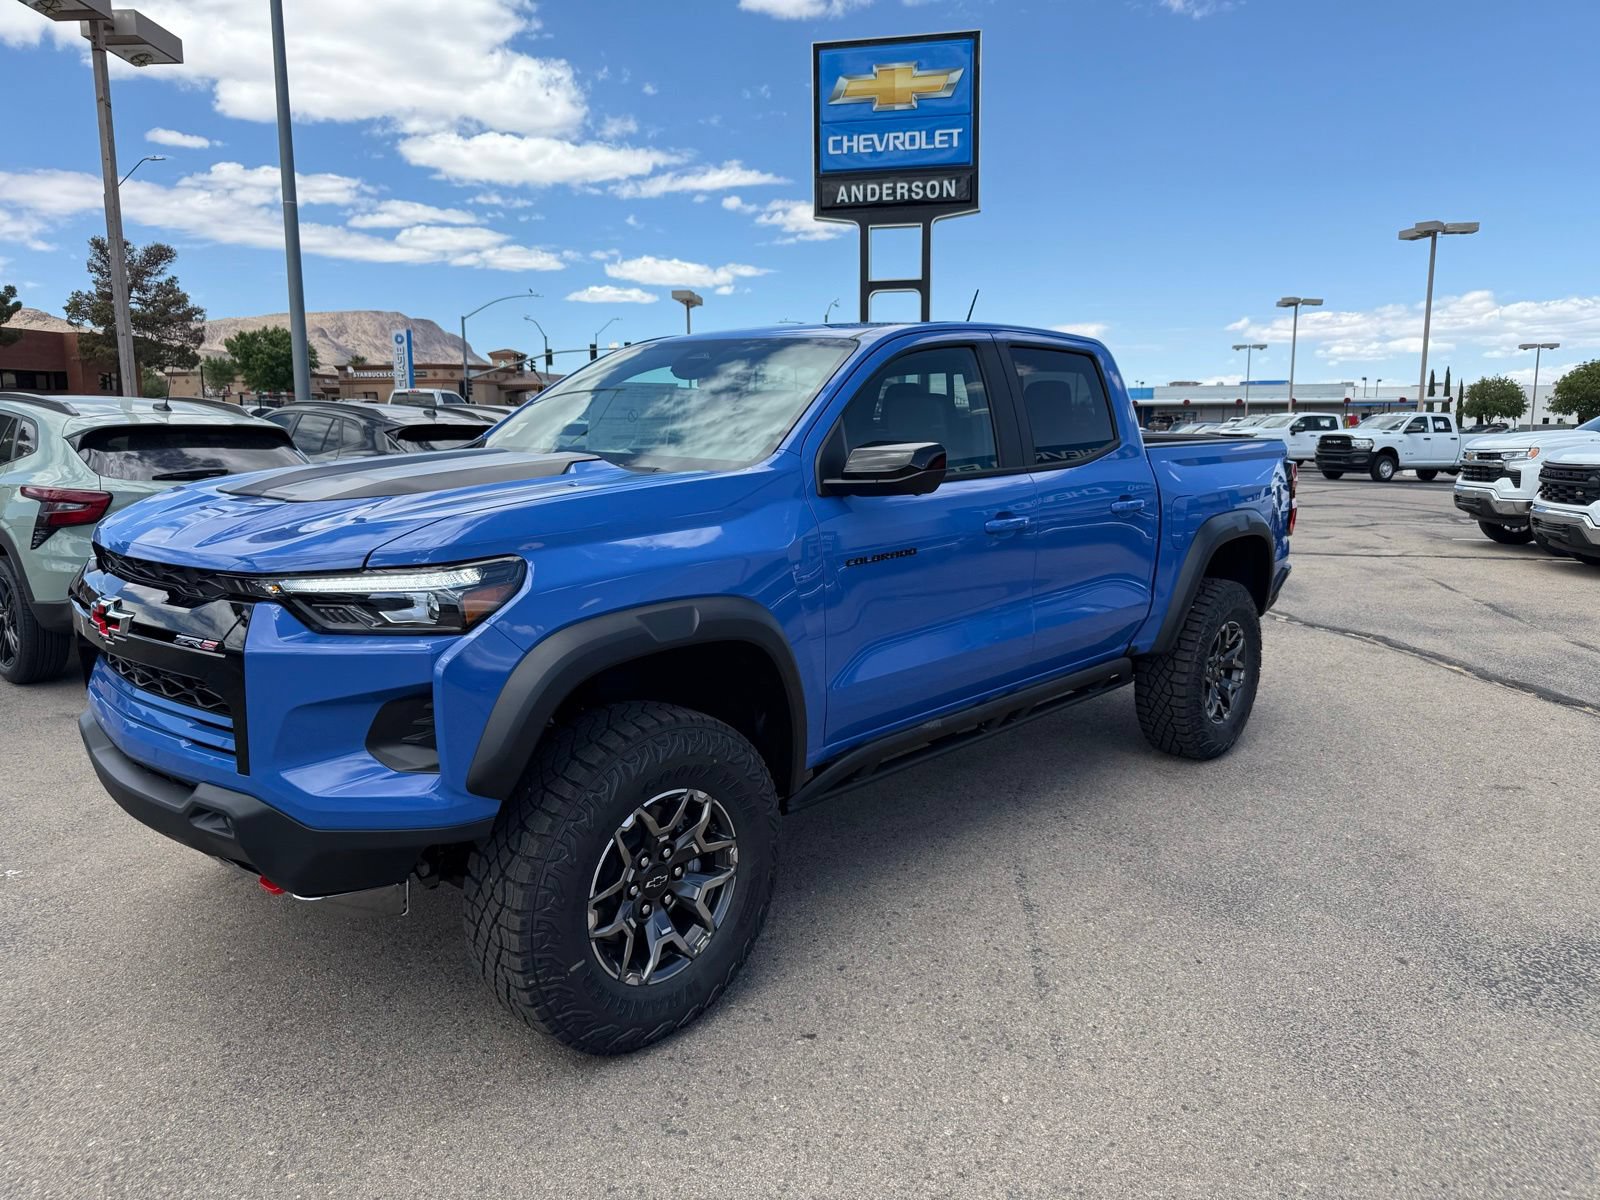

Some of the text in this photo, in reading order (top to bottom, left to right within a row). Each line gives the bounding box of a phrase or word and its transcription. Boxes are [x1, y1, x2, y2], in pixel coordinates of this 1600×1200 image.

[827, 127, 963, 155] CHEVROLET
[836, 179, 956, 204] ANDERSON
[353, 370, 387, 378] STARBUCKS
[396, 346, 407, 389] CHASE
[845, 547, 917, 568] COLORADO
